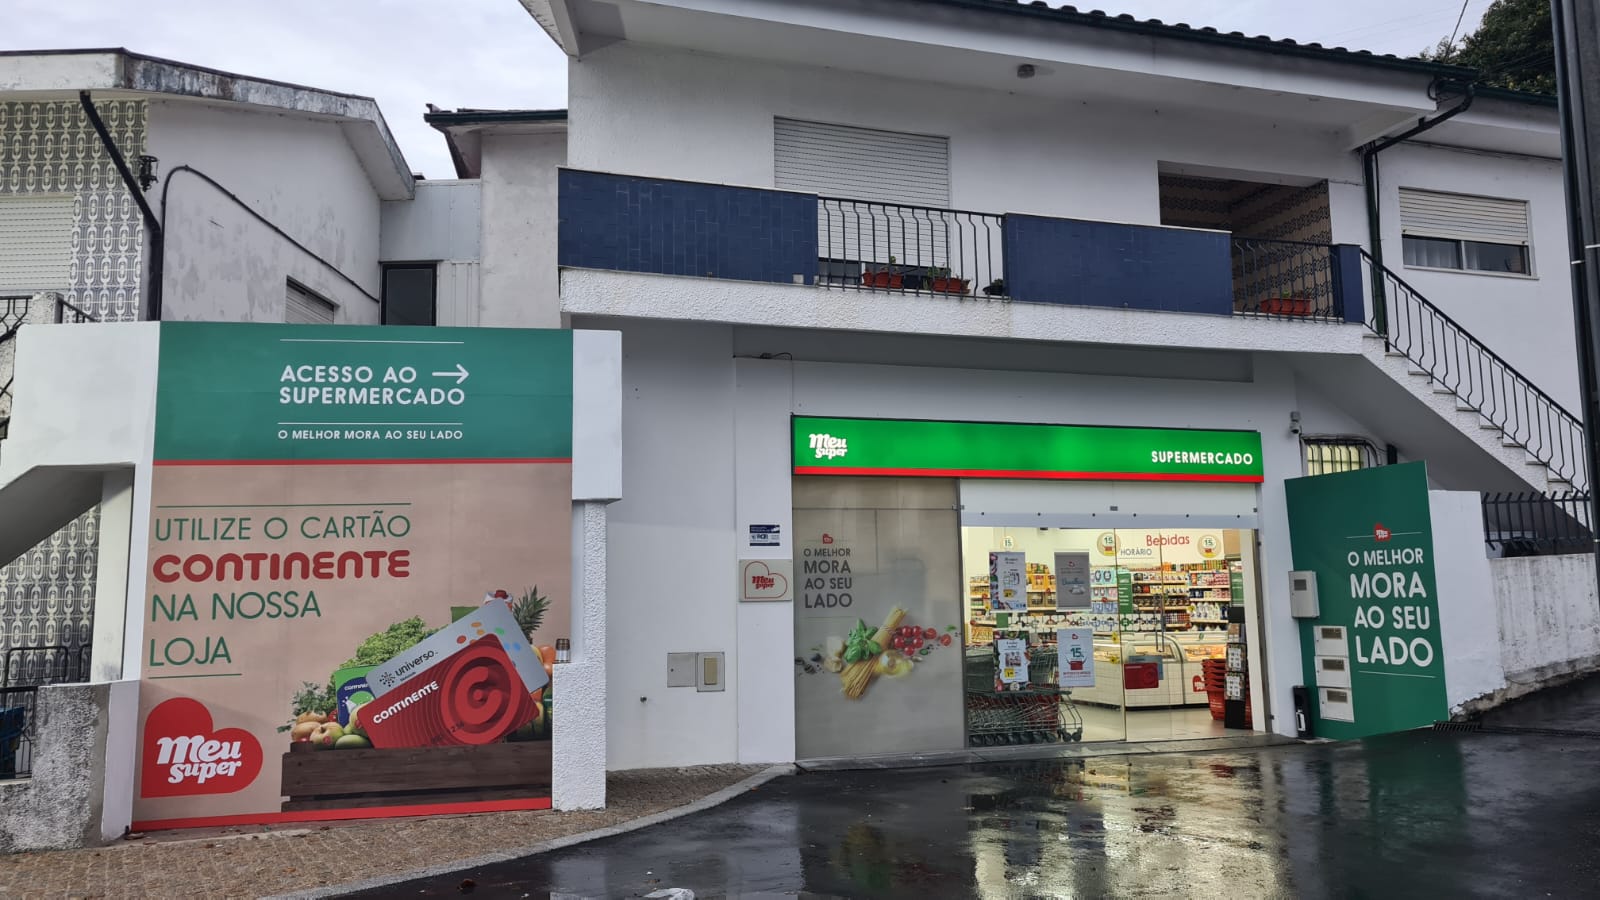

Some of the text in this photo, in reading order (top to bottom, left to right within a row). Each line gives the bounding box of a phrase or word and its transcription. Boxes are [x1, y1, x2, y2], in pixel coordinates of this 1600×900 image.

[280, 365, 417, 383] ACESSO AO
[279, 386, 465, 405] SUPERMERCADO
[278, 430, 463, 440] O MELHOR MORA AO SEU LADO
[808, 433, 848, 448] Meu
[815, 447, 848, 460] super
[1151, 451, 1253, 465] SUPERMERCADO
[154, 510, 411, 541] UTILIZE O CARTÃO
[1146, 534, 1190, 547] Bebidas
[803, 547, 851, 557] O MELHOR
[1120, 547, 1152, 556] HORÁRIO
[1347, 548, 1424, 566] O MELHOR
[152, 549, 411, 583] CONTINENTE
[803, 560, 851, 574] MORA
[804, 577, 852, 590] AO SEU
[1350, 571, 1427, 599] MORA
[151, 590, 322, 622] NA NOSSA
[804, 592, 852, 608] LADO
[1353, 605, 1430, 630] AO SEU
[149, 636, 232, 668] LOJA
[1355, 635, 1434, 667] LADO
[394, 650, 435, 677] universo
[373, 681, 439, 724] CONTINENTE
[156, 735, 242, 764] Meu
[168, 761, 242, 784] super
